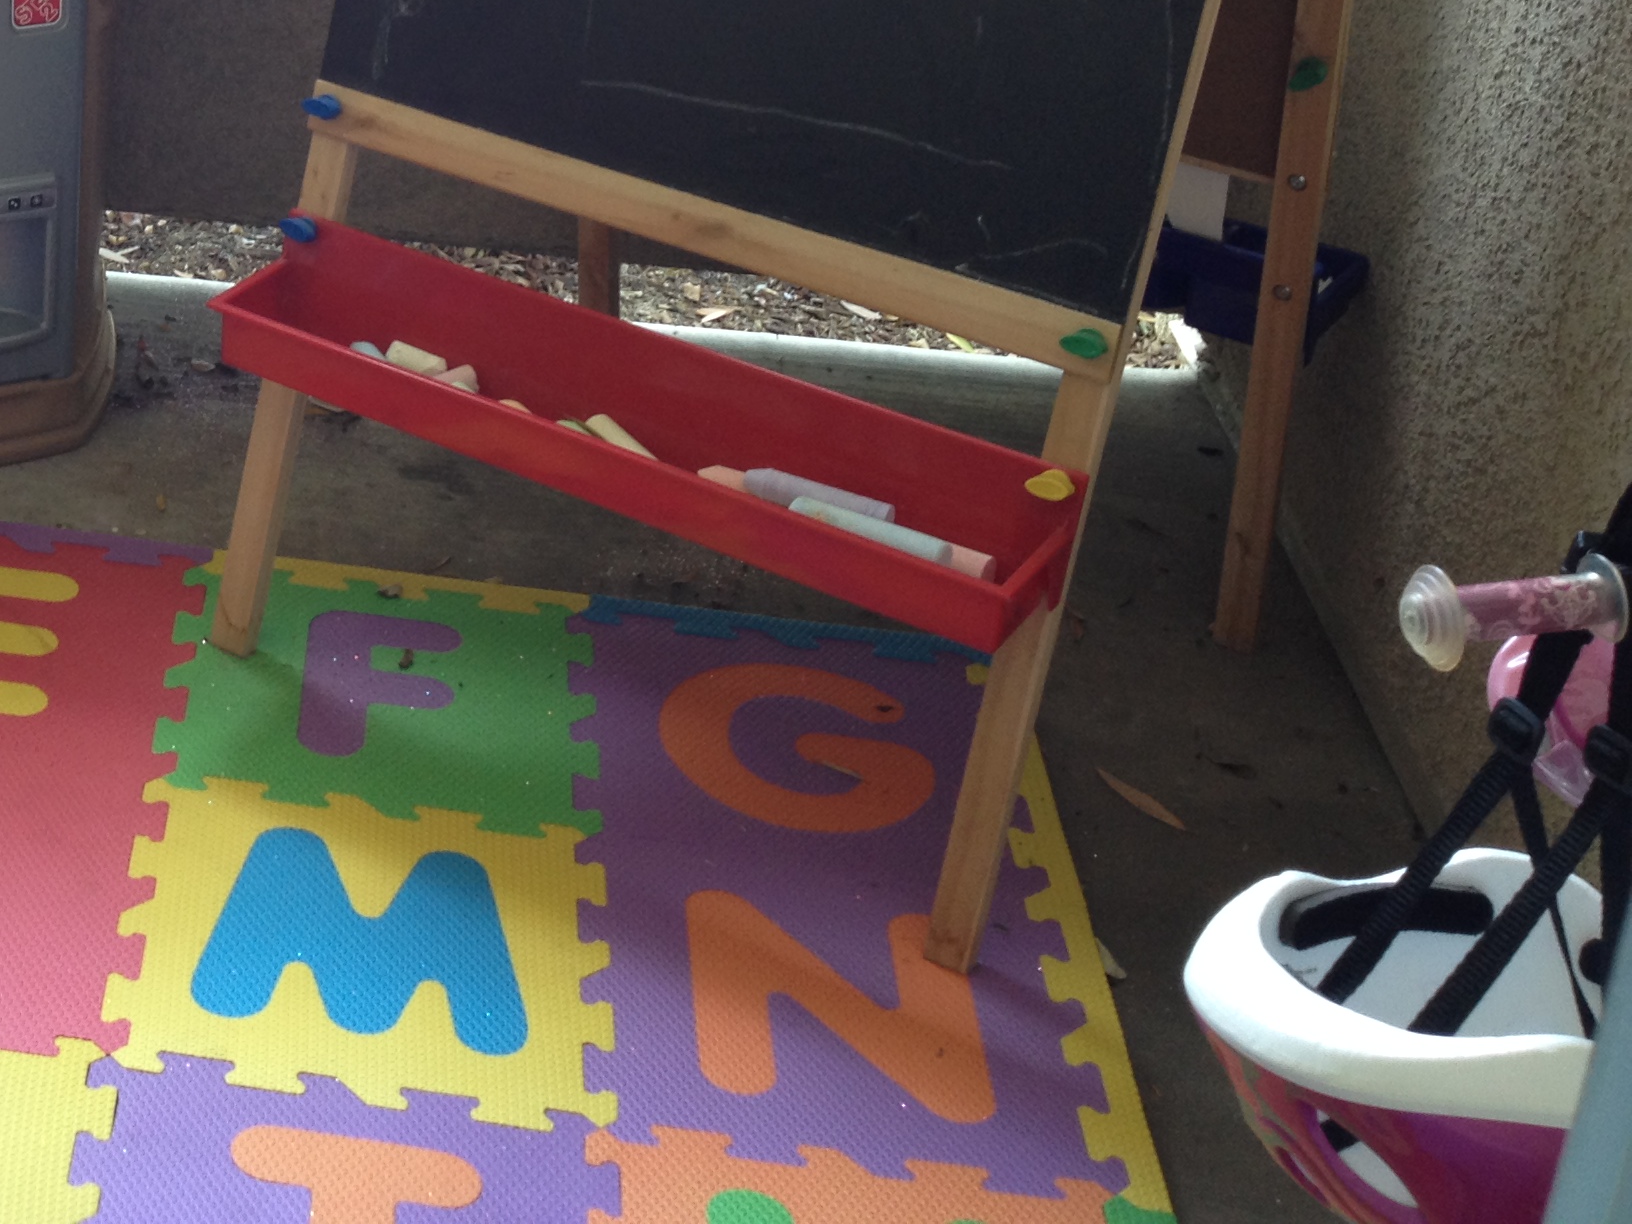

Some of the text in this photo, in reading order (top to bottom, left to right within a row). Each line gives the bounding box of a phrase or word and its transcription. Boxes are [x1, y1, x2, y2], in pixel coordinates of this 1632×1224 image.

[40, 2, 59, 23] 2
[296, 609, 461, 756] F
[659, 662, 934, 832] G
[190, 826, 529, 1055] M
[684, 889, 996, 1122] N
